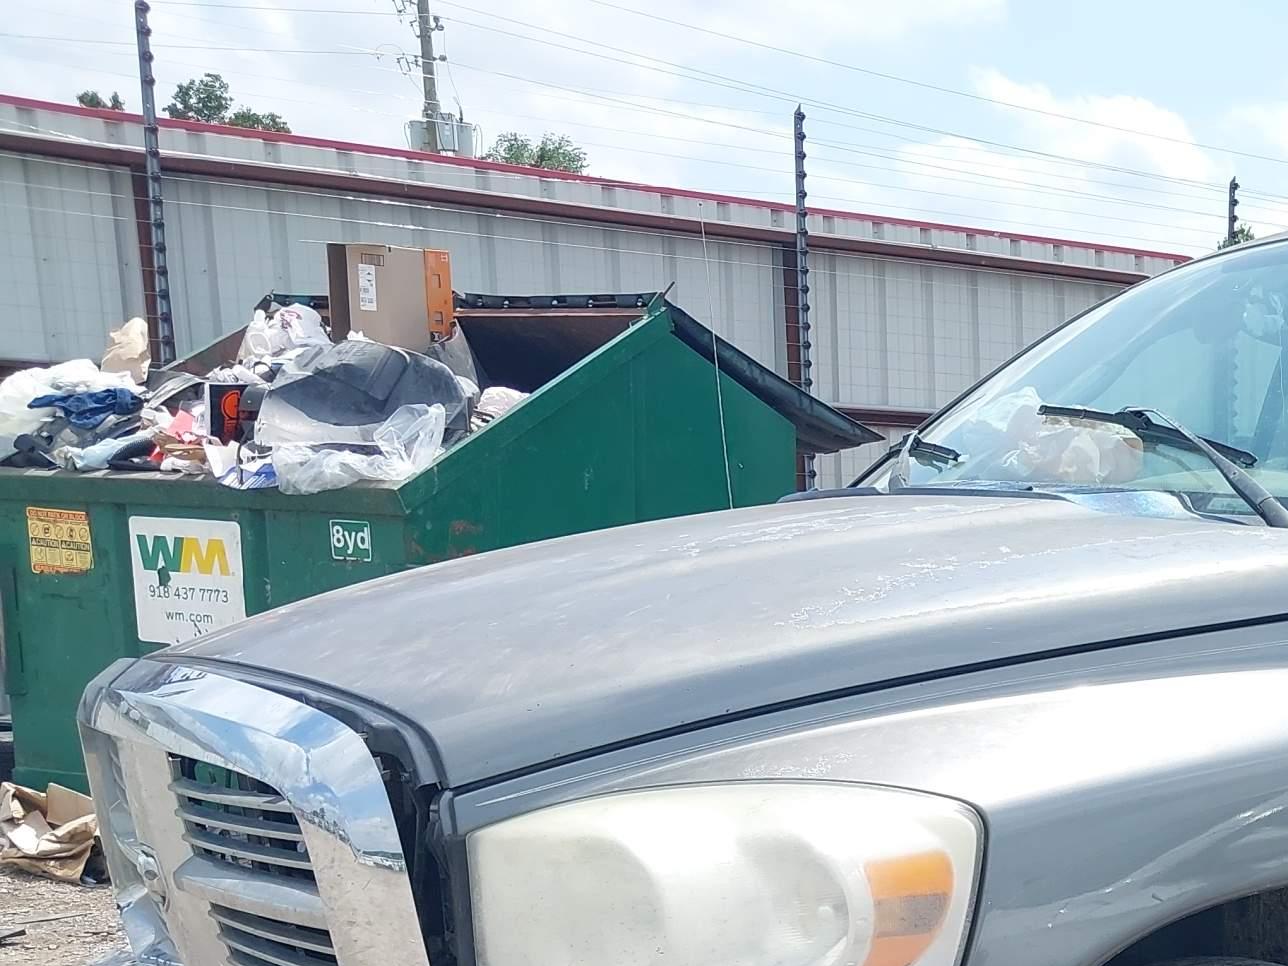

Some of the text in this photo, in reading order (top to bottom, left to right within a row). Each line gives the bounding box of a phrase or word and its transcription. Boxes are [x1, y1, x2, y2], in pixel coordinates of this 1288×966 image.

[333, 525, 369, 554] 8yd
[136, 534, 231, 576] WM
[149, 584, 229, 603] 918 437 7773
[166, 611, 213, 624] wm.com
